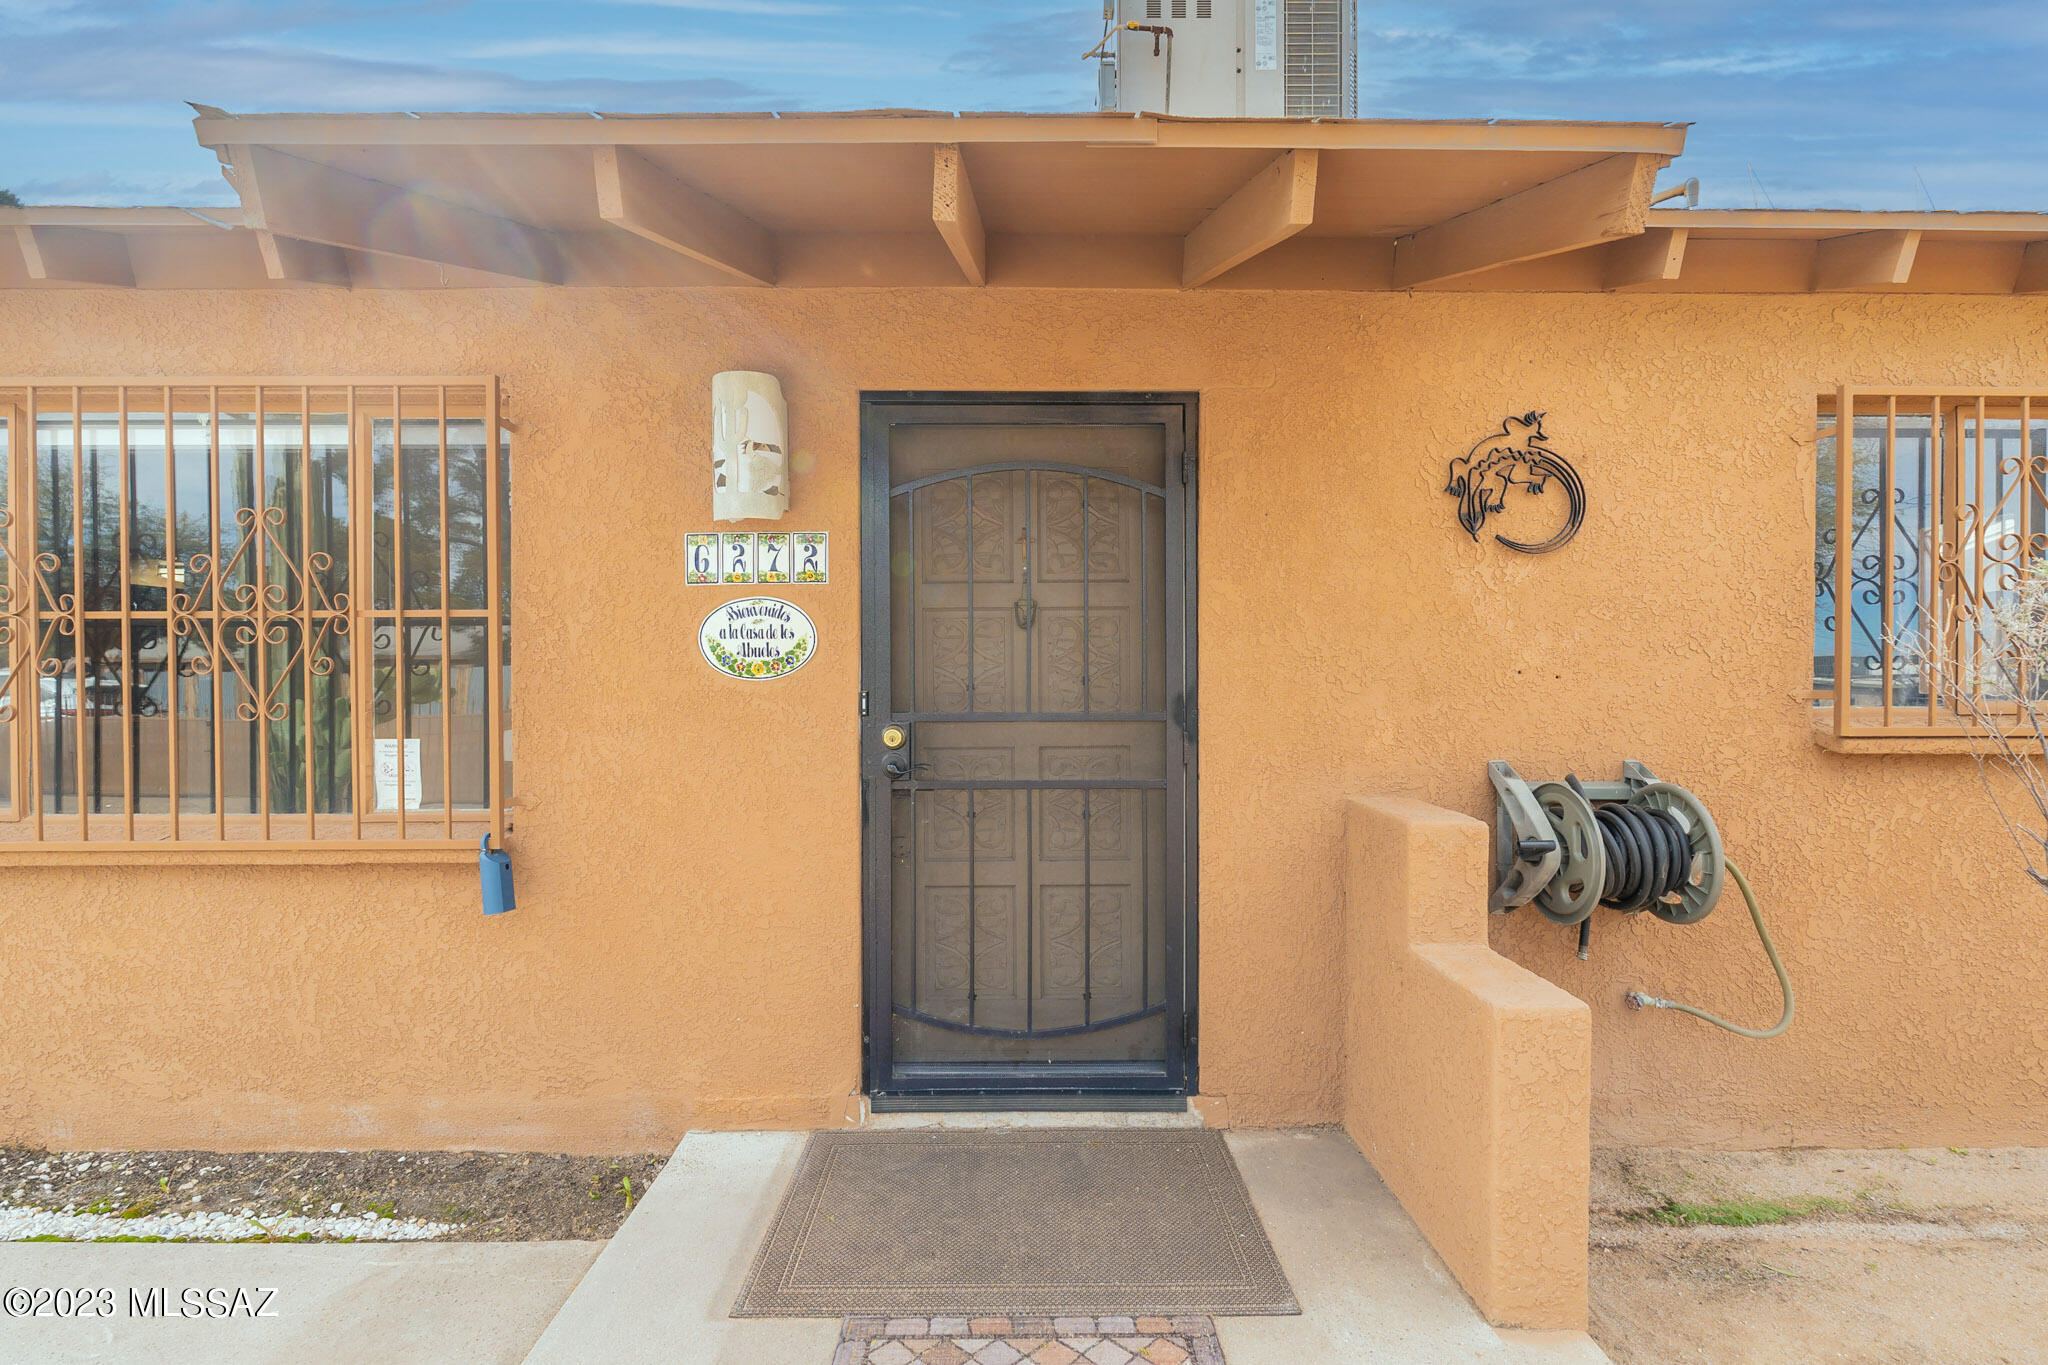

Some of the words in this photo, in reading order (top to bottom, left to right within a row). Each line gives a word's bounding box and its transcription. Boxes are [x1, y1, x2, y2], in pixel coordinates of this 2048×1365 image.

[694, 543, 818, 573] 6272
[726, 604, 791, 622] Bienvenidos
[719, 628, 727, 640] a
[729, 623, 739, 640] la
[740, 623, 764, 640] Casa
[766, 623, 778, 640] de
[780, 623, 795, 640] los
[737, 642, 780, 658] Abuelos
